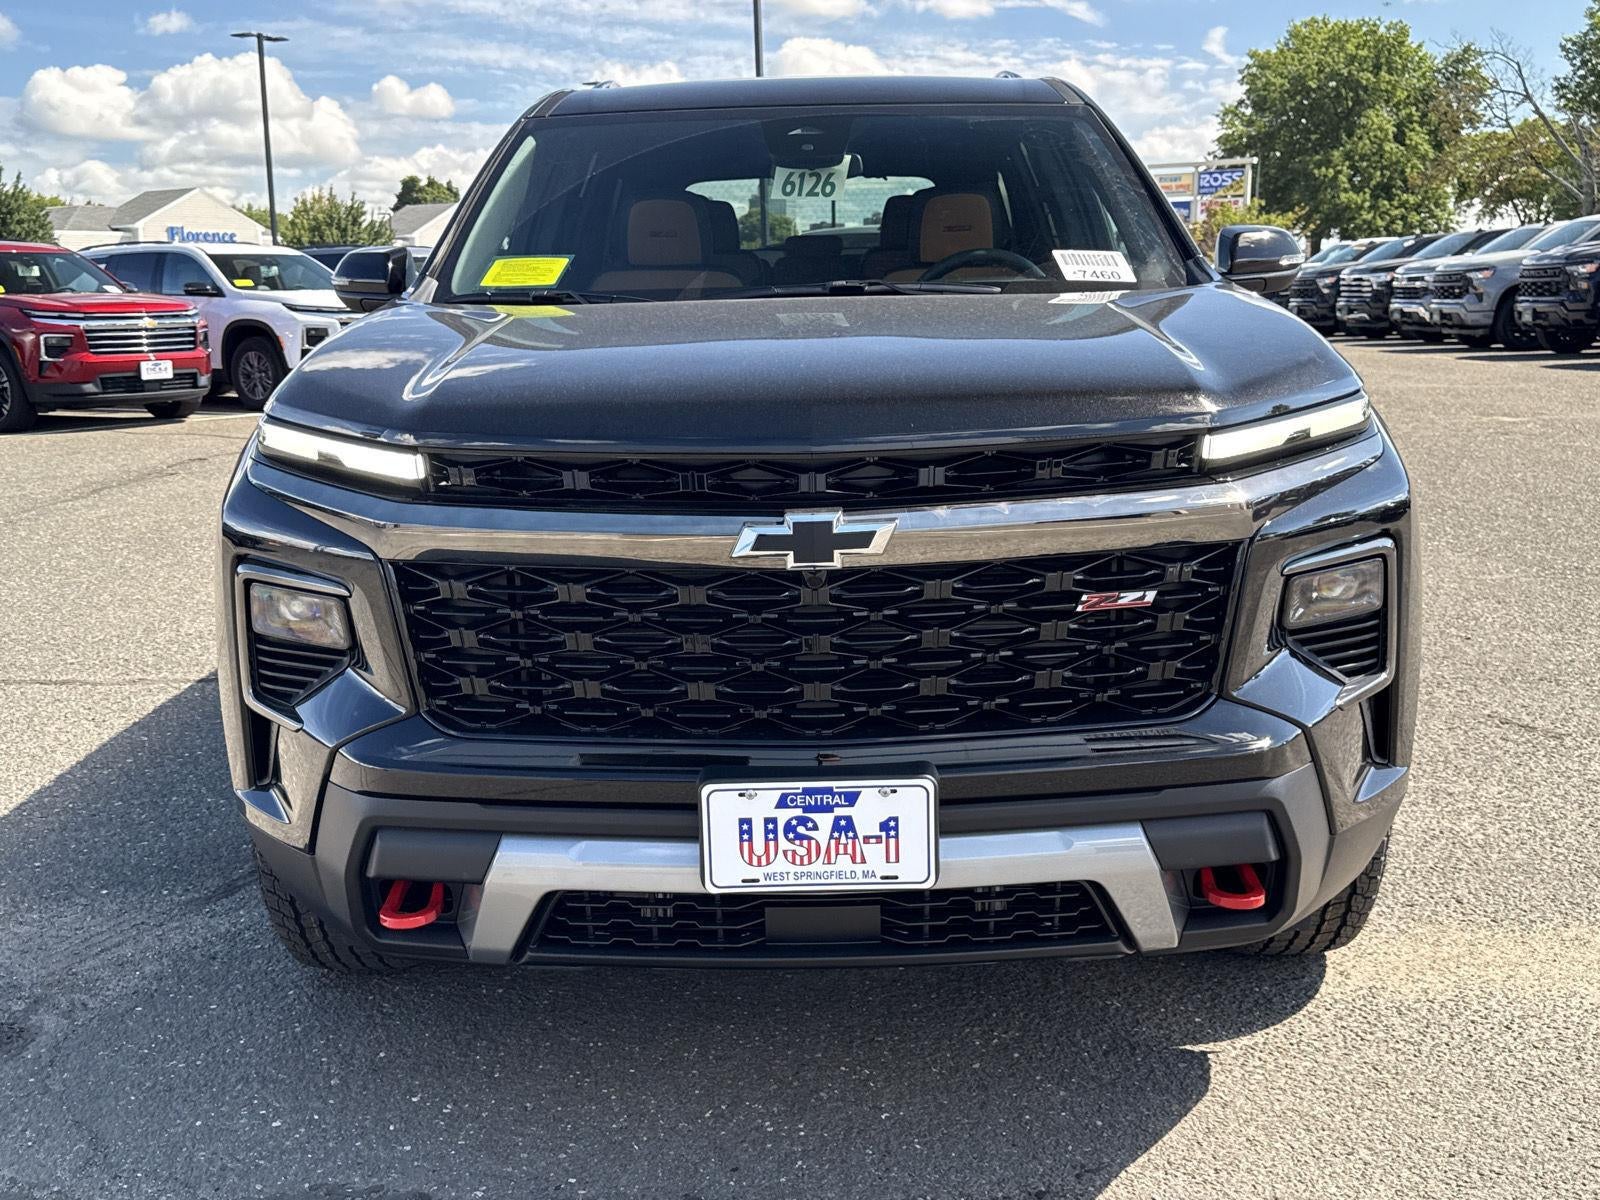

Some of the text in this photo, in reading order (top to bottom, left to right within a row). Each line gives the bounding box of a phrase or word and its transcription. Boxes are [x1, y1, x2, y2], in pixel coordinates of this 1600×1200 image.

[781, 171, 837, 198] 6126
[1199, 171, 1243, 187] ROSS
[165, 225, 237, 243] Florence
[786, 793, 849, 807] CENTRAL
[738, 815, 900, 868] USA-1
[763, 869, 877, 882] WEST SPRINGFIELD, MA
